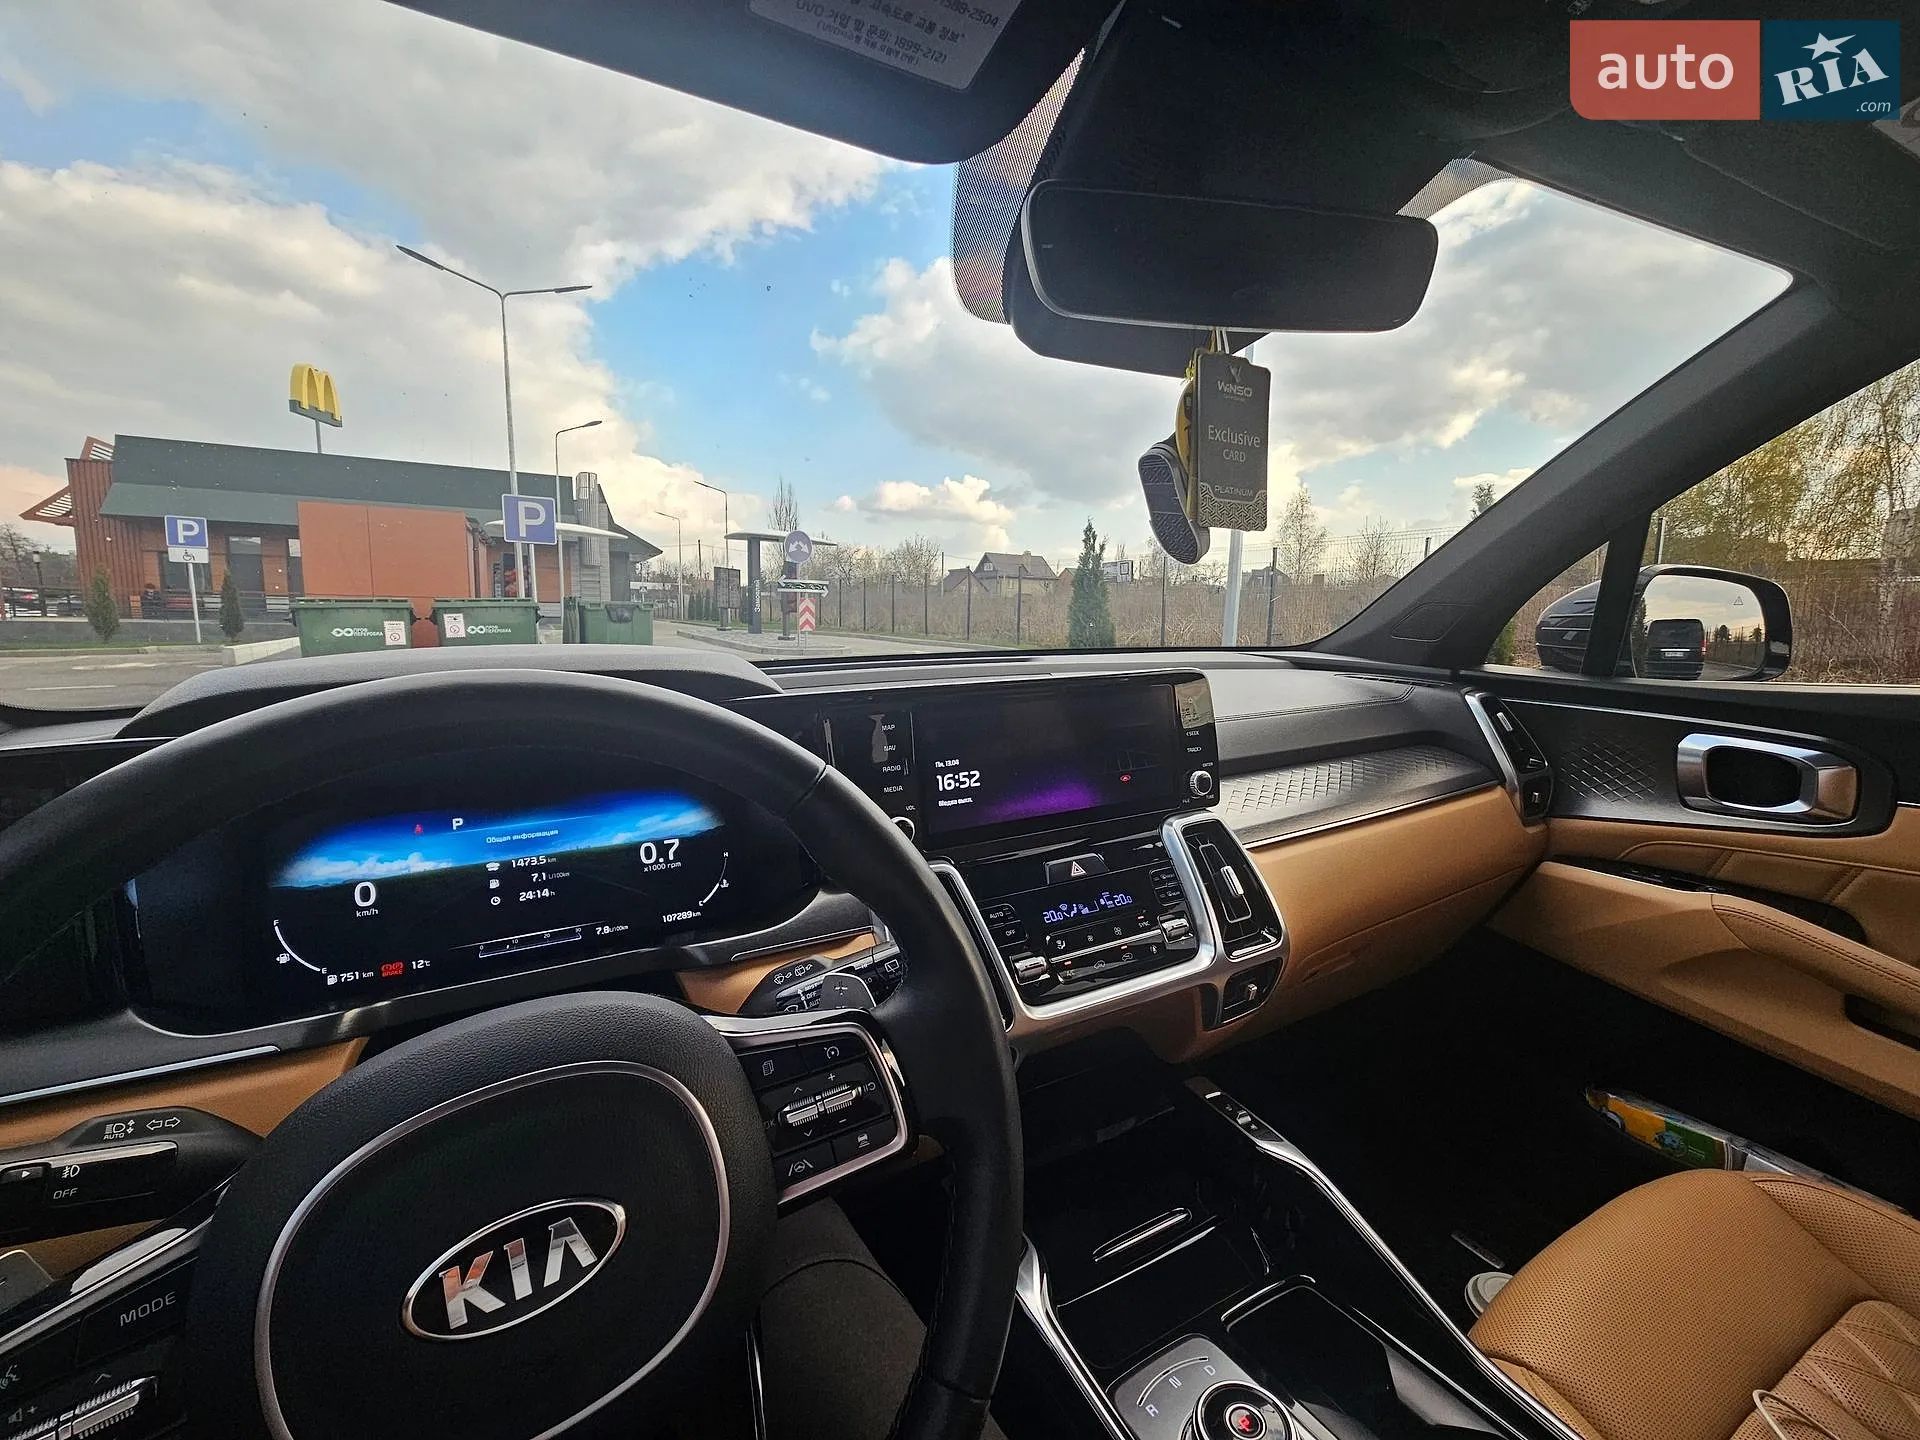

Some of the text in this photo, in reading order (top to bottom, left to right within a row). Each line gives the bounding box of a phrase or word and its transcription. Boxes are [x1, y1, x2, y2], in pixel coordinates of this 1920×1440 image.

[934, 0, 1000, 27] 588-2504
[1208, 424, 1261, 448] Exclusive
[1222, 448, 1246, 463] CARD
[1214, 484, 1255, 498] PLATINUM
[517, 500, 546, 538] P
[176, 519, 200, 544] P
[881, 723, 896, 732] MAP
[883, 744, 897, 752] NAV
[882, 764, 902, 773] RADIO
[936, 770, 981, 792] 16:52
[883, 784, 904, 794] MEDIA
[452, 817, 464, 831] P
[486, 829, 559, 844] Общая информация
[640, 838, 680, 864] 0.7
[511, 855, 547, 868] 1473.5
[643, 861, 682, 873] x1000 rpm
[531, 872, 546, 883] 7.1
[354, 881, 377, 908] 0
[519, 888, 550, 902] 24:14
[356, 907, 379, 917] km/h
[989, 911, 1004, 919] AUTO
[1005, 928, 1017, 937] OFF
[340, 970, 375, 982] 751 km
[806, 991, 817, 1000] OFF
[809, 999, 821, 1007] AUT
[103, 1132, 125, 1141] AUTO
[53, 1187, 79, 1200] OFF
[438, 1216, 598, 1330] KIA
[119, 1292, 177, 1327] MODE
[1203, 1364, 1217, 1377] D
